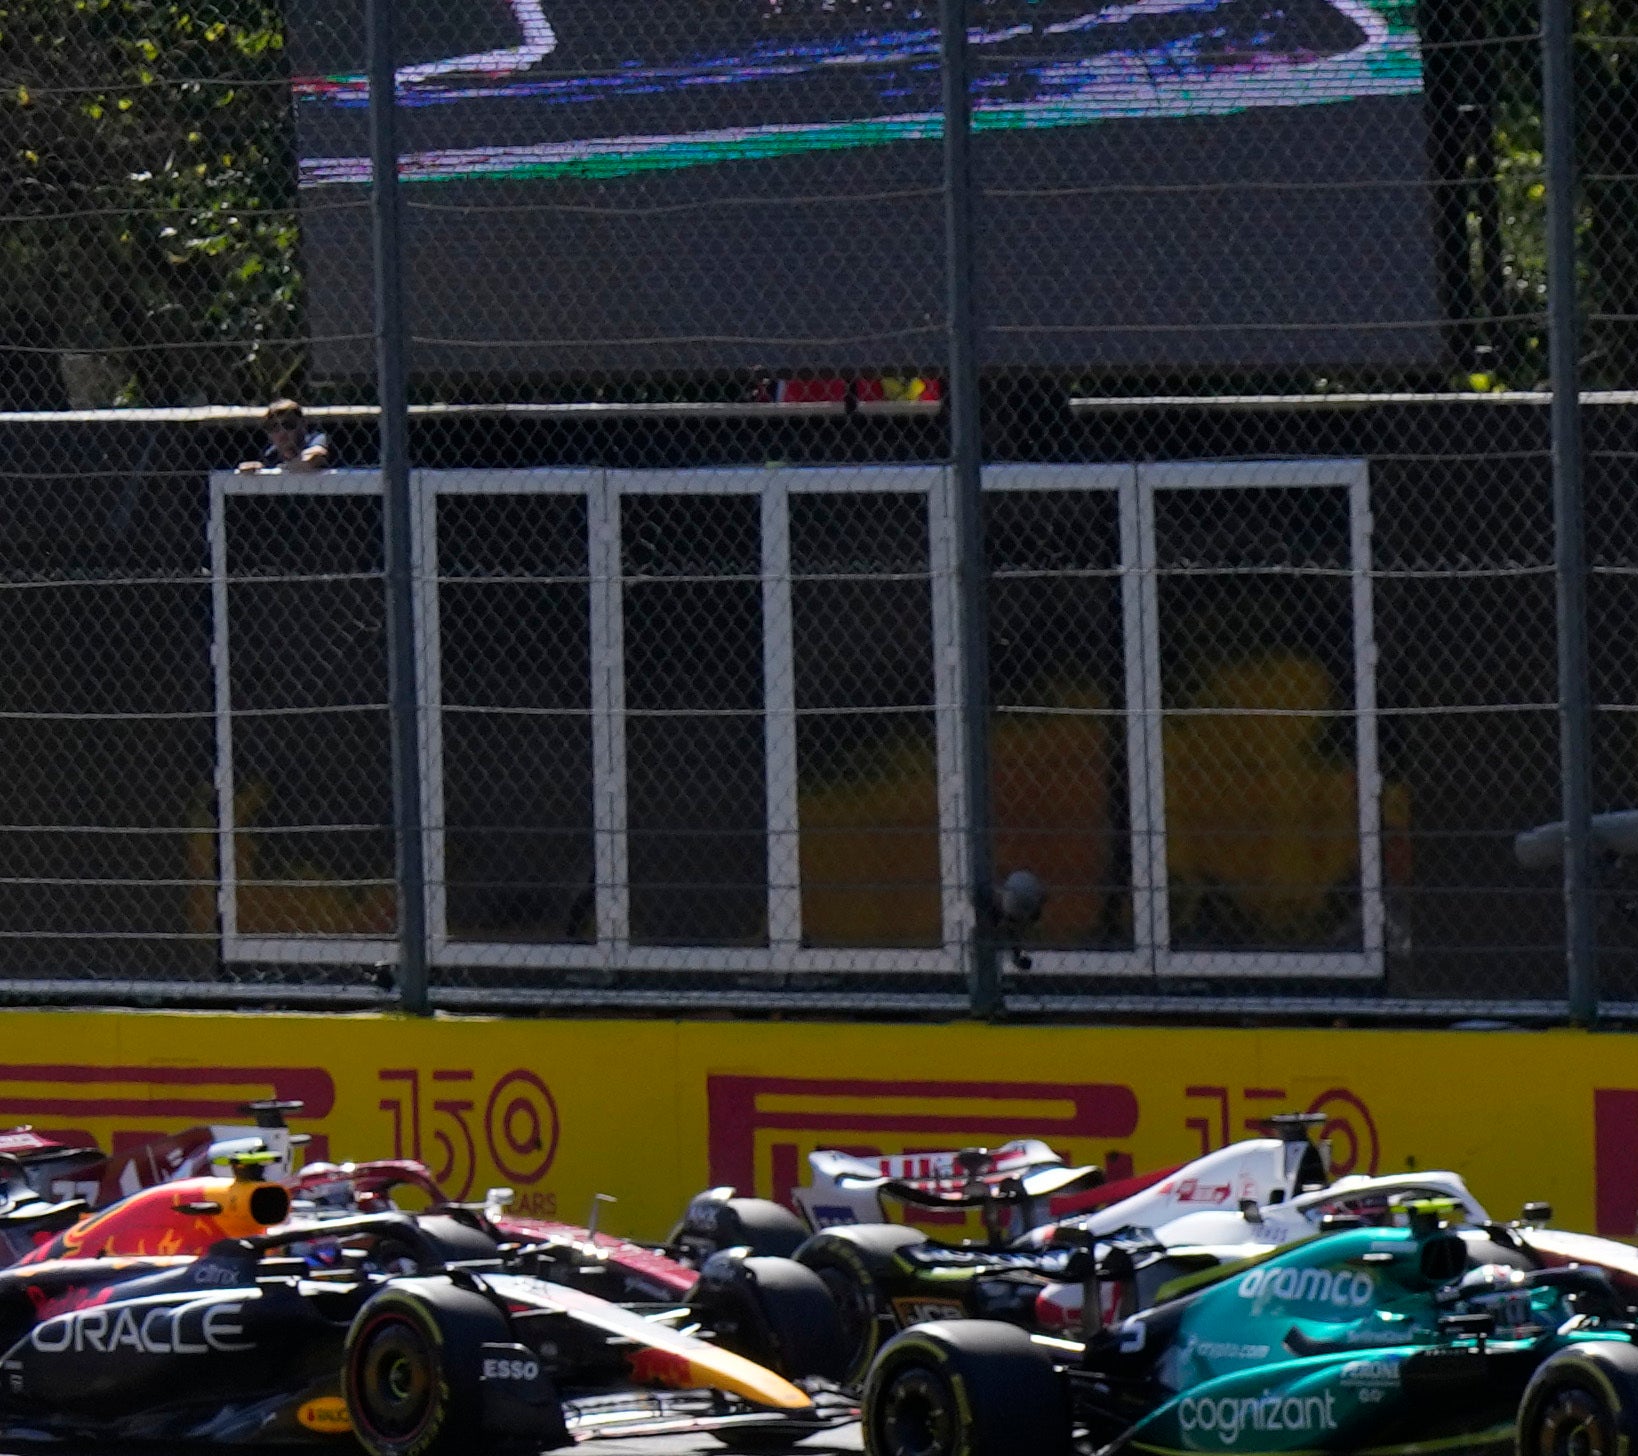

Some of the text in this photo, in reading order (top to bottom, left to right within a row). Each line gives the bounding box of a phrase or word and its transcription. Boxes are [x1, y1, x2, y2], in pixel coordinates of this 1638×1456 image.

[1237, 1266, 1375, 1307] aramco
[31, 1302, 257, 1354] ORACLE
[482, 1357, 538, 1382] ESSO
[1177, 1388, 1339, 1445] cognizant
